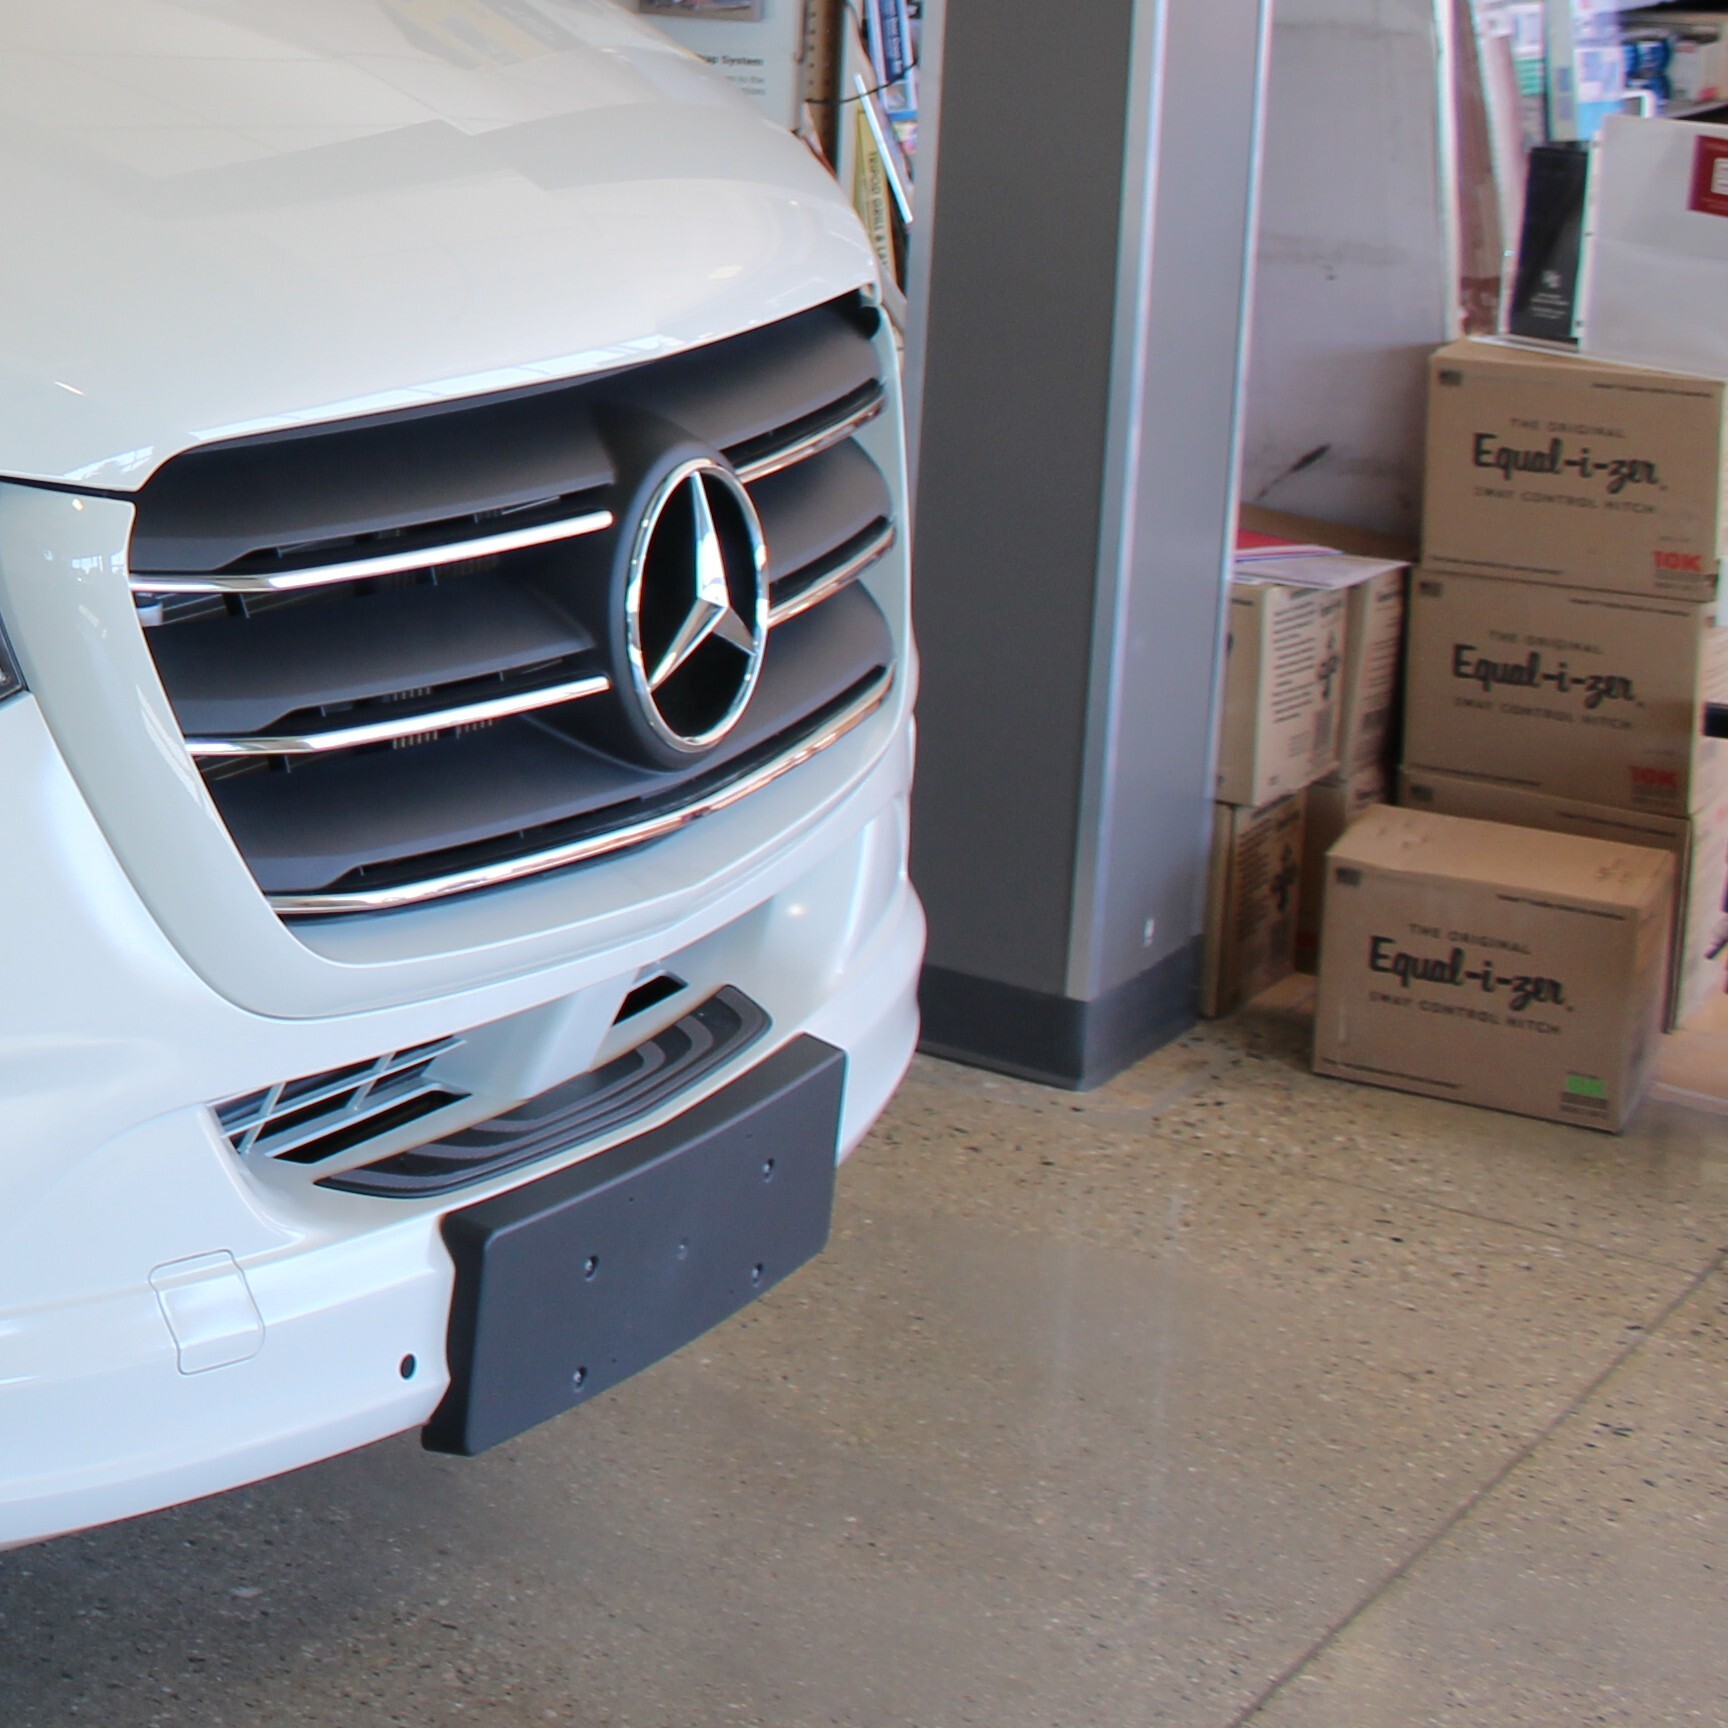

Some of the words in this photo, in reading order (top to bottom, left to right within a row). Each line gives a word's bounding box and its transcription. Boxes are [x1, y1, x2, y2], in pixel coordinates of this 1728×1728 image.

[721, 54, 764, 67] System
[1510, 418, 1541, 430] THE
[1548, 421, 1625, 439] ORIGINAL
[1473, 432, 1659, 495] Equal-i-zer
[1474, 486, 1515, 499] SWAY
[1520, 490, 1598, 509] CONTROL
[1604, 500, 1657, 515] HITCH
[1452, 643, 1635, 709] Equal-i-zer
[1409, 922, 1441, 939] THE
[1447, 930, 1531, 955] ORIGINAL
[1369, 935, 1565, 1011] Equal-i-zer
[1369, 990, 1413, 1007] SWAY
[1419, 999, 1499, 1024] CONTROL
[1506, 1017, 1562, 1035] HITCH
